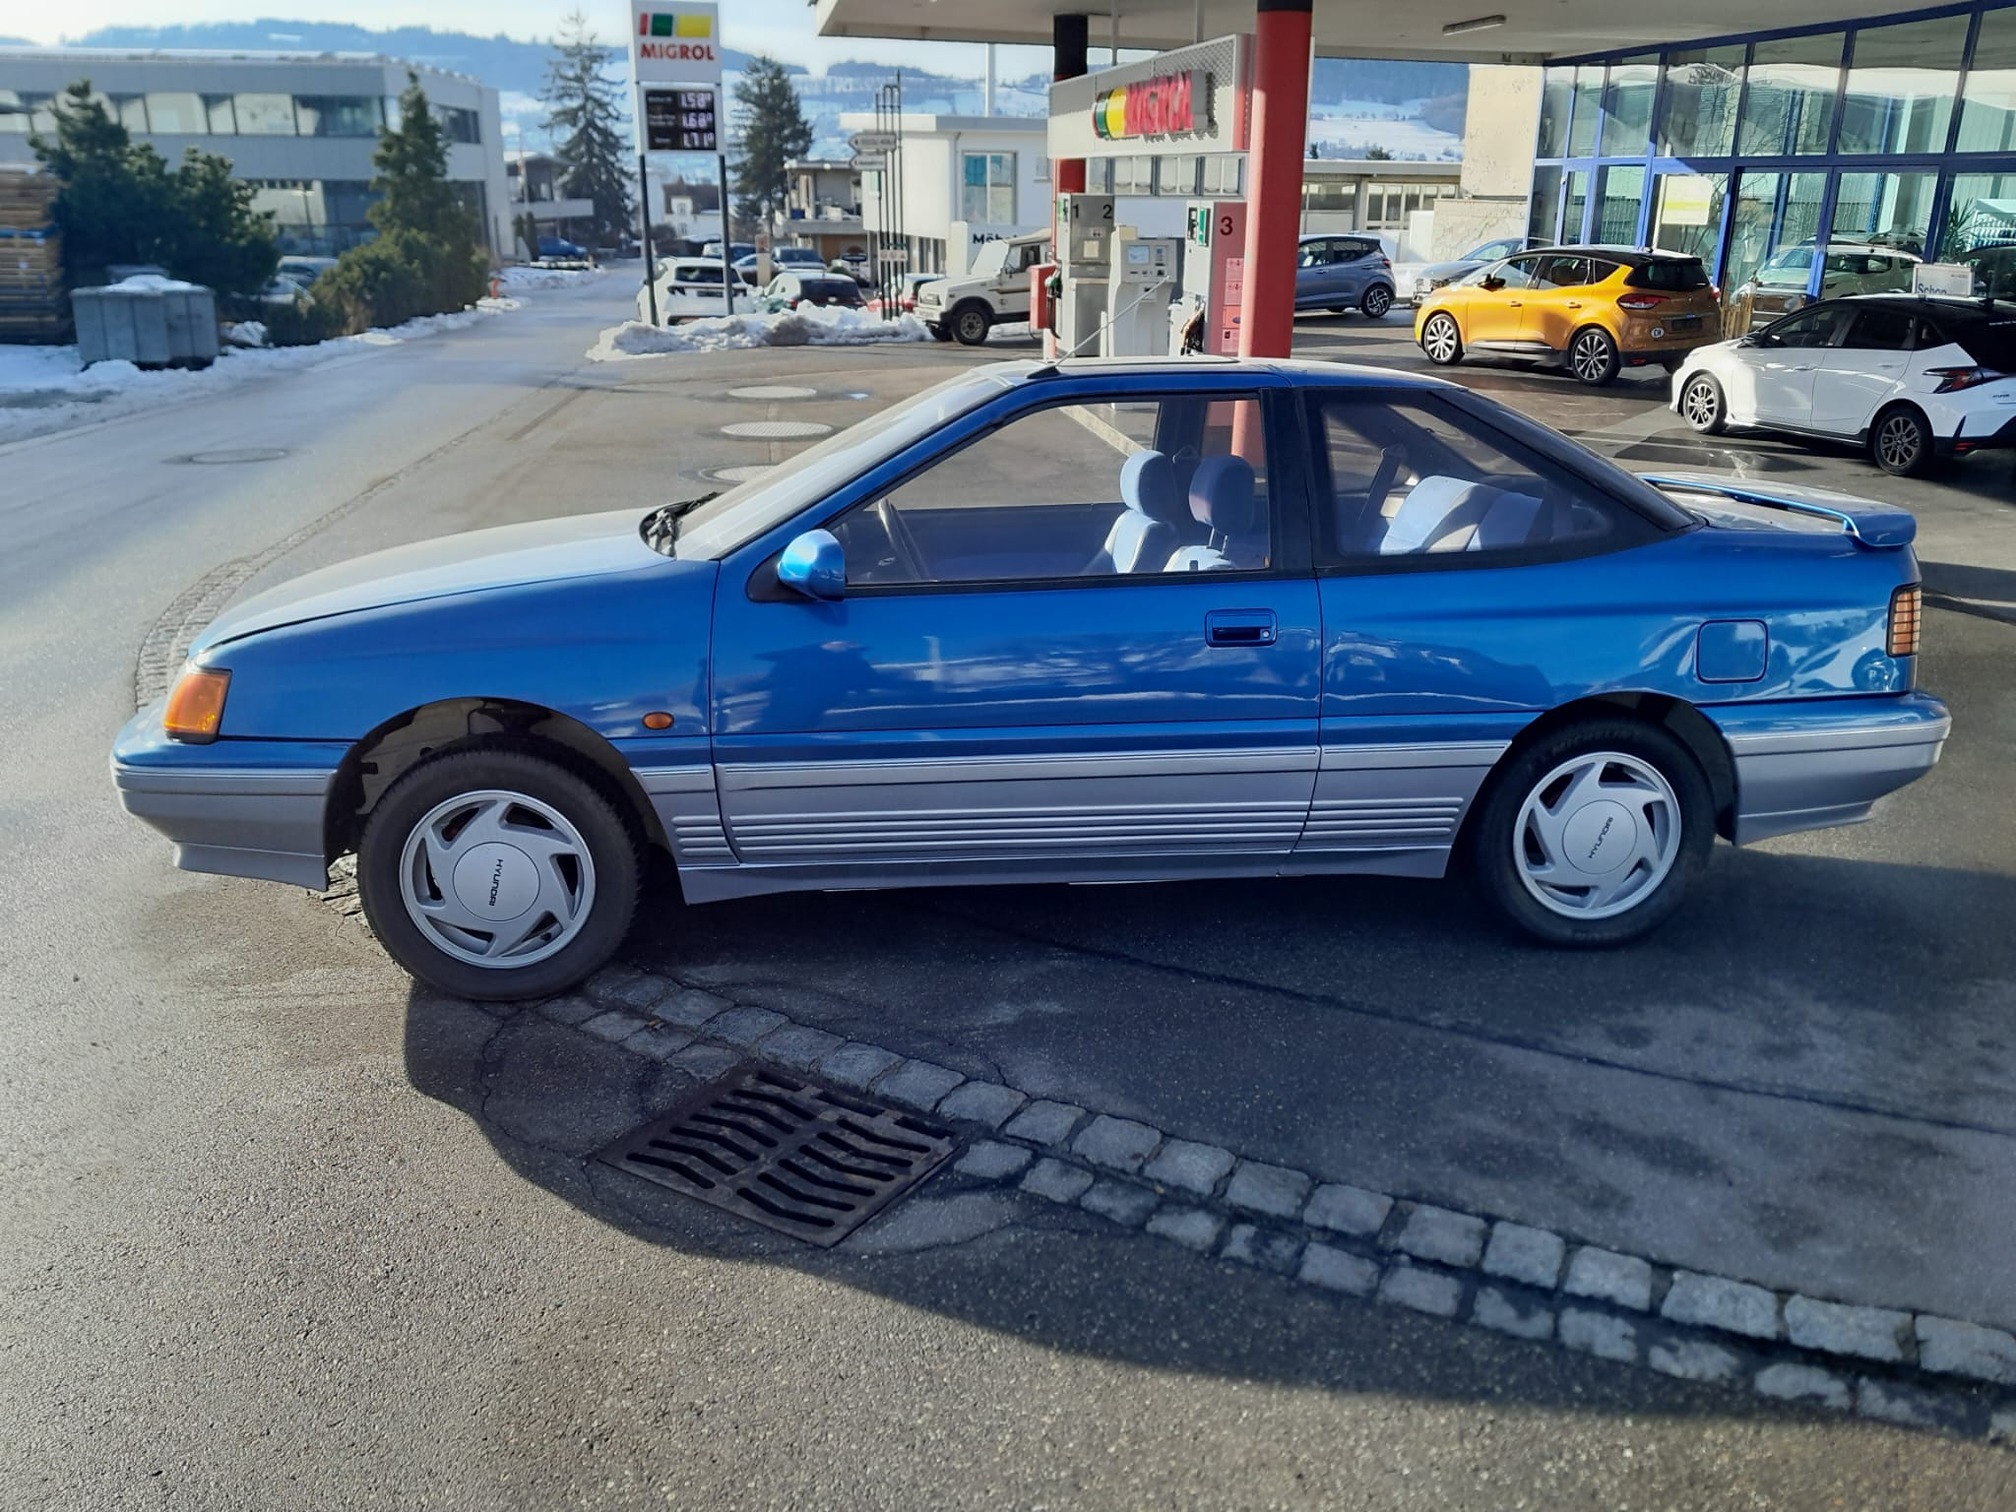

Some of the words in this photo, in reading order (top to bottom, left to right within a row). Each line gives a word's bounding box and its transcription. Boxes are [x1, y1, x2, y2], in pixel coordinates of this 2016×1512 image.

[640, 43, 714, 60] MIGROL
[1072, 203, 1079, 219] 1
[1102, 204, 1113, 219] 2
[1220, 216, 1233, 236] 3
[488, 858, 504, 906] HYUNDAI
